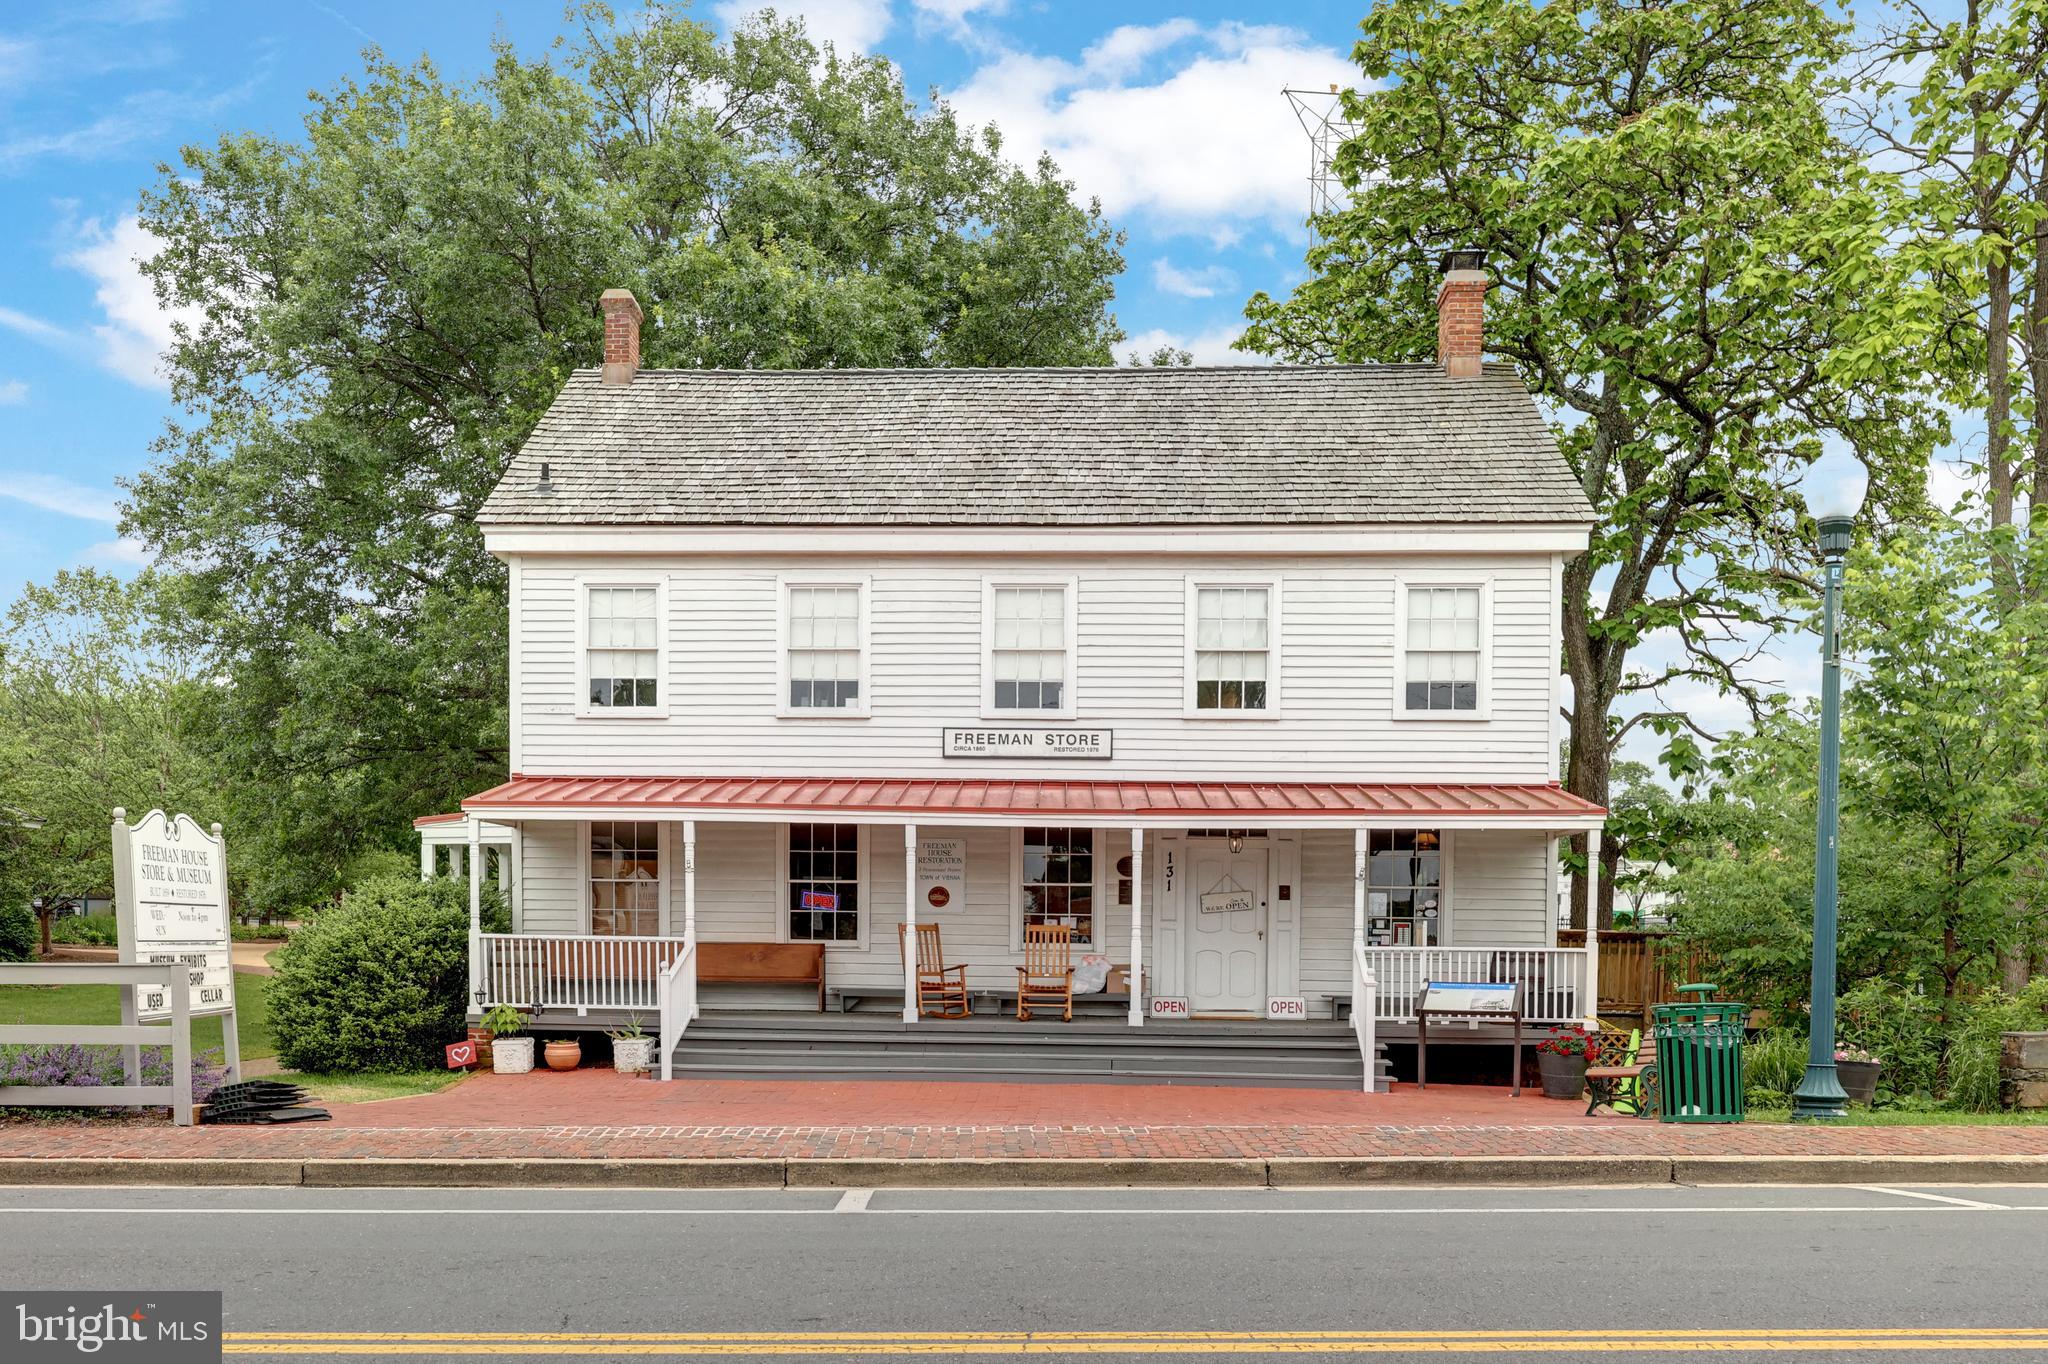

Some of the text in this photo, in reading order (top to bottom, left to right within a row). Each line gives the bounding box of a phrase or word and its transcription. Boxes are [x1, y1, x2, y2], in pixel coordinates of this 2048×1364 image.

[954, 733, 1100, 746] FREEMAN STORE
[142, 844, 209, 866] FREEMAN HOUSE
[918, 856, 962, 864] RESTORATION
[927, 849, 953, 857] HOUSE
[141, 864, 212, 885] STORE & MUSEUM
[1166, 851, 1174, 892] 131
[805, 894, 834, 908] OPEN
[1225, 902, 1249, 910] OPEN
[180, 954, 207, 968] EXHIBITS
[189, 972, 204, 986] SHOP
[147, 989, 224, 1008] USED CELLAR
[1154, 1001, 1186, 1013] OPEN
[1271, 1001, 1303, 1014] OPEN
